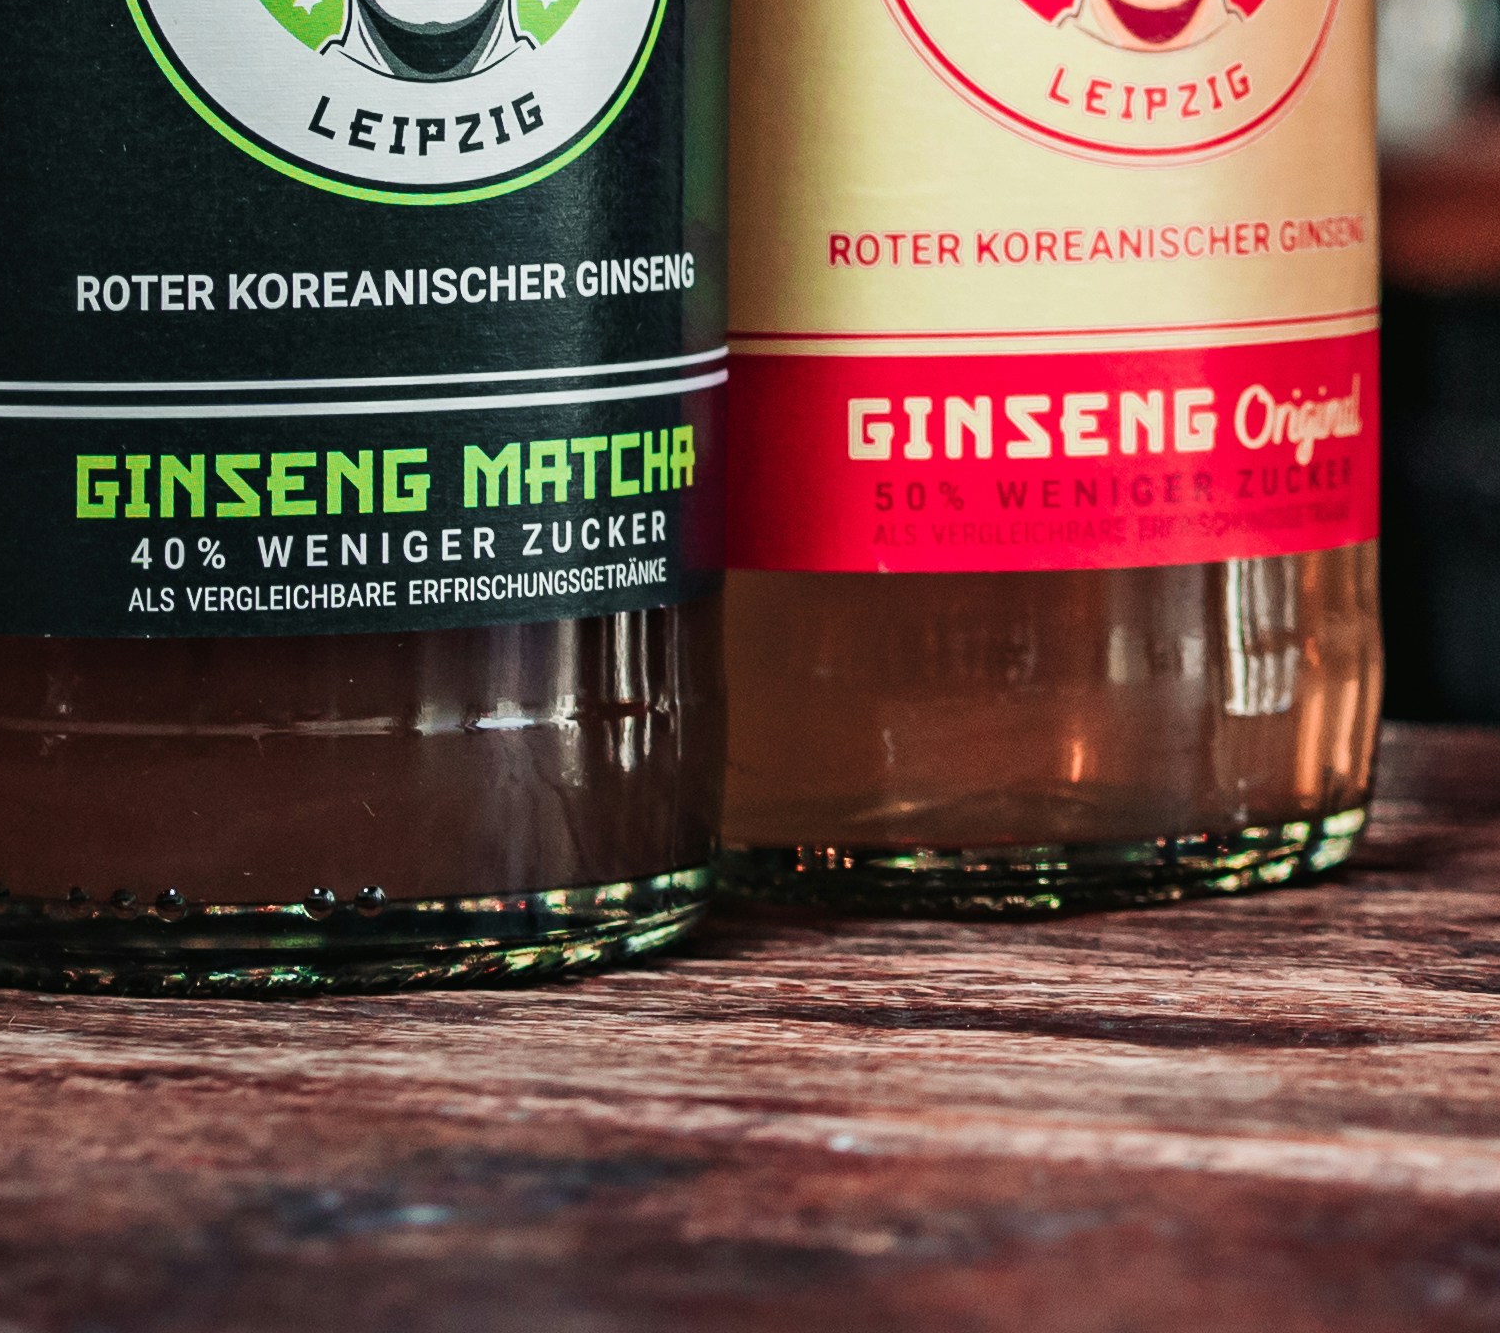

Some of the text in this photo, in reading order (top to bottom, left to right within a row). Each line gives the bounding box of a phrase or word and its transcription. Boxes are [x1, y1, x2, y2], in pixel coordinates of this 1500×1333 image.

[1048, 62, 1254, 121] LEIPZIG
[307, 90, 545, 157] LEIPZIG
[827, 232, 961, 269] ROTER
[975, 220, 1270, 267] KOREANISCHER
[76, 251, 695, 312] ROTER KOREANISCHER GINSENG
[847, 388, 1218, 461] GINSENG
[75, 423, 696, 519] GINSENG MATCHA
[874, 481, 966, 513] 50%
[997, 470, 1215, 511] WENIGER
[130, 509, 668, 571] 40% WENIGER ZUCKER
[128, 556, 668, 613] ALS VERGLEICHBARE ERFRISCHUNGSGETRÄNKE
